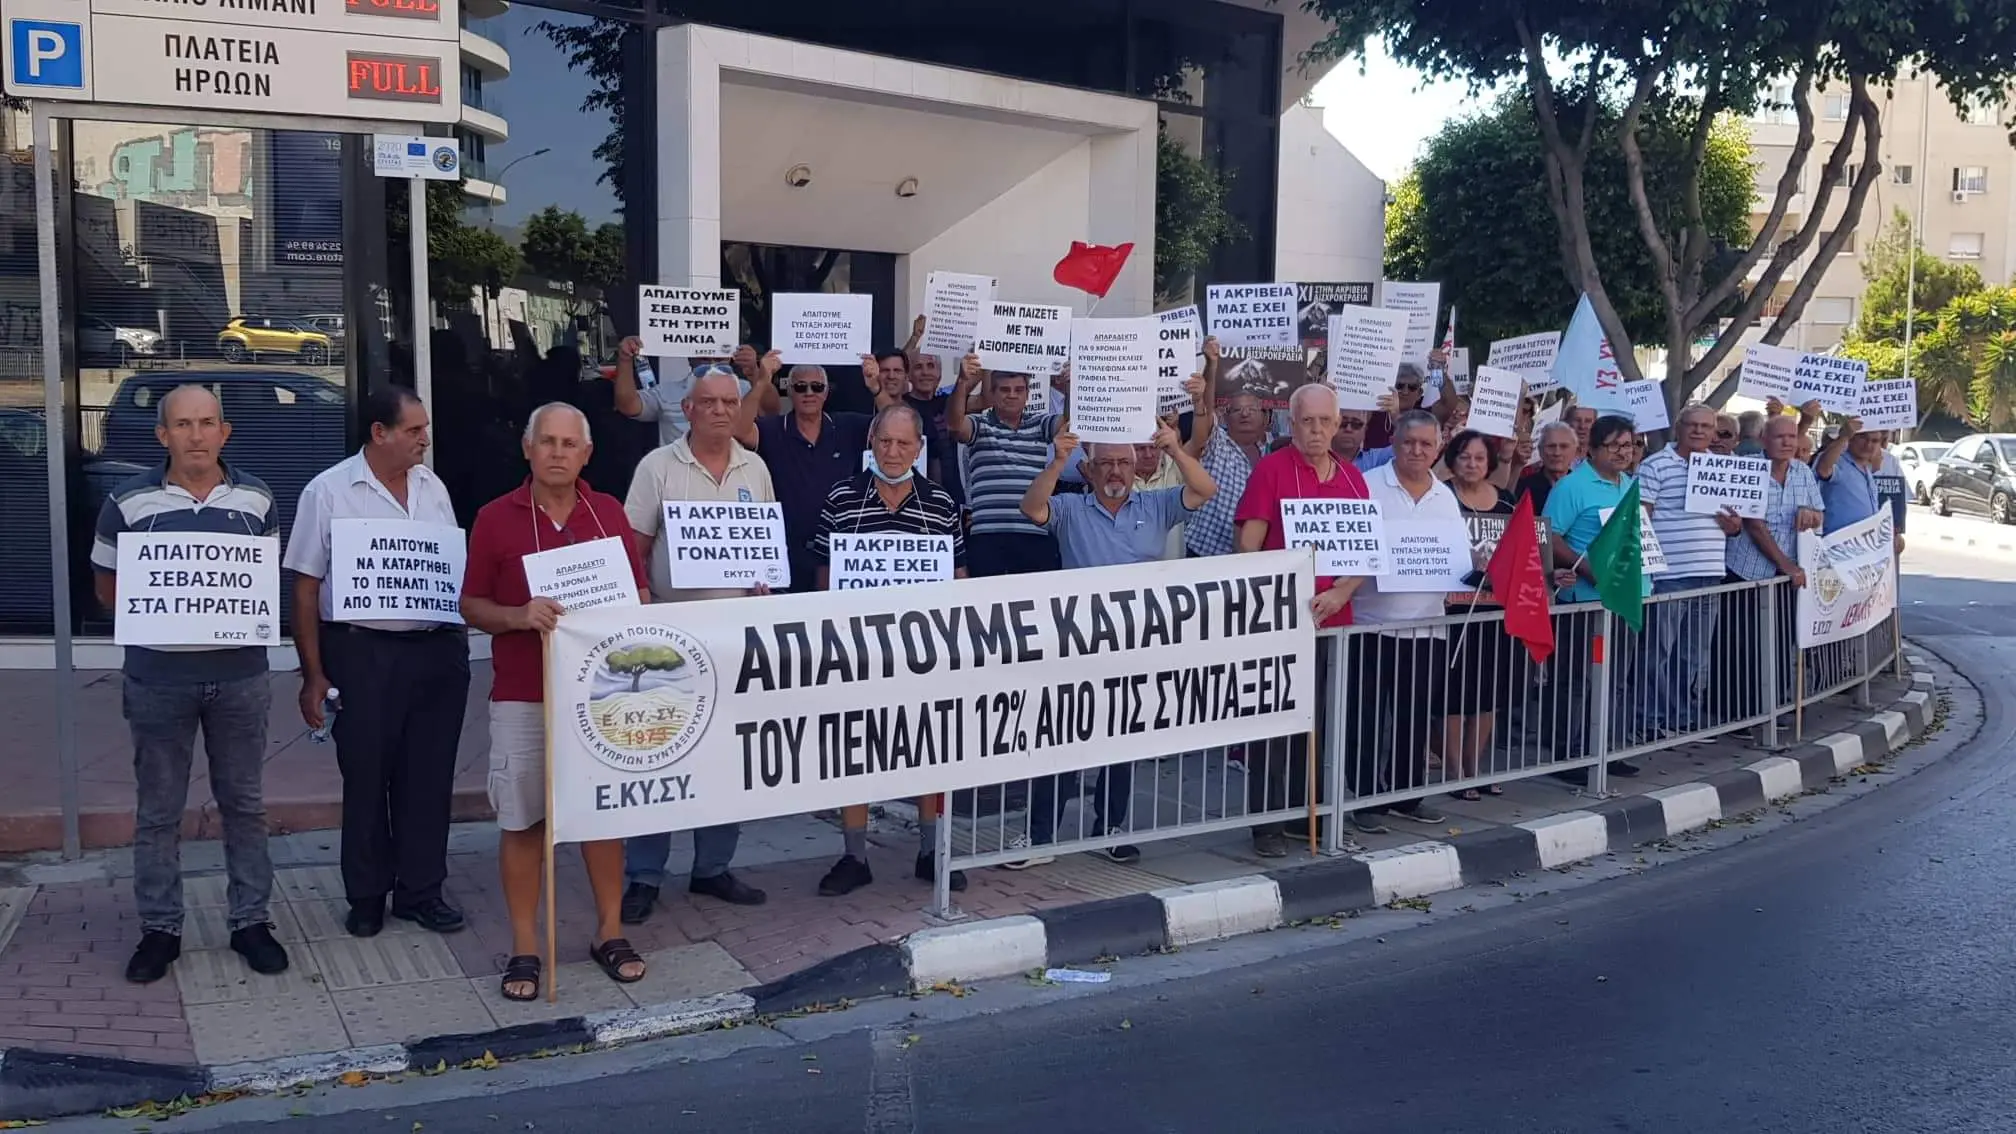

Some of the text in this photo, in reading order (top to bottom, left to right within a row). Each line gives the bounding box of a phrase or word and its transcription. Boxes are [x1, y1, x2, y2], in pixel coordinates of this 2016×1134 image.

[28, 30, 65, 77] P
[165, 34, 280, 65] ΠΛΑΤΕΙΑ
[175, 68, 271, 97] ΗΡΩΩΝ
[349, 60, 440, 96] FULL
[643, 288, 736, 301] ΑΠΑΙΤΟΥΜΕ
[1209, 286, 1293, 299] Η ΑΚΡΙΒΕΙΑ
[1298, 285, 1313, 302] ΧΙ
[650, 303, 728, 316] ΣΕΒΑΣΜΟ
[802, 310, 842, 319] ΑΠΑΙΤΟΥΜΕ
[993, 304, 1058, 320] ΜΗΝ ΠΑΙΖΕΤΕ
[1159, 308, 1196, 323] ΡΙΒΕΙΑ
[1217, 302, 1285, 314] ΜΑΣ ΕΧΕΙ
[648, 318, 730, 330] ΣΤΗ ΤΡΙΤΗ
[1006, 323, 1044, 337] ΜΕ ΤΗΝ
[1213, 316, 1290, 329] ΓΟΝΑΤΙΣΕΙ
[663, 333, 716, 345] ΗΛΙΚΙΑ
[978, 339, 1067, 357] ΑΞΙΟΠΡΕΠΕΙΑ ΜΑΣ
[1800, 355, 1865, 373] ΑΚΡΙΒΕΙΑ
[1824, 370, 1856, 385] ΕΧΕΙ
[1793, 379, 1857, 398] ΟΝΑΤΙΣΕΙ
[1883, 392, 1908, 403] ΕΧΕΙ
[1857, 404, 1912, 417] ΟΝΑΤΙΣΕΙ
[1692, 456, 1769, 472] Η ΑΚΡΙΒΕΙΑ
[1697, 471, 1760, 486] ΜΑΣ ΕΧΕΙ
[1692, 485, 1763, 500] ΓΟΝΑΤΙΣΕΙ
[667, 506, 779, 520] Η ΑΚΡΙΒΕΙΑ
[1284, 503, 1378, 516] Η ΑΚΡΙΒΕΙΑ
[681, 526, 771, 540] ΜΑΣ ΕΧΕΙ
[1294, 521, 1372, 534] ΜΑΣ ΕΧΕΙ
[370, 538, 440, 555] ΑΠΑΙΤΟΥΜΕ
[833, 539, 949, 552] Η ΑΚΡΙΒΕΙΑ
[1291, 539, 1379, 551] ΓΟΝΑΤΙΣΕΙ
[138, 544, 263, 563] ΑΠΑΙΤΟΥΜΕ
[677, 546, 780, 560] ΓΟΝΑΤΙΣΕΙ
[356, 557, 451, 575] ΝΑ ΚΑΤΑΡΓΗΘΕΙ
[556, 558, 606, 575] ΑΠΑΡΑΔΕΚΤΟ
[844, 558, 938, 572] ΜΑΣ ΕΧΕΙ
[1331, 559, 1360, 567] ΕΚΥΣΥ
[148, 571, 253, 588] ΣΕΒΑΣΜΟ
[723, 570, 756, 578] ΕΚΥΣΥ
[352, 576, 457, 594] ΤΟ ΠΕΝΑΛΤΙ 12%
[540, 583, 553, 592] ΓΙΑ
[561, 576, 590, 589] ΧΡΟΝΙΑ
[553, 588, 590, 601] ΒΕΡΝΗΣΗ
[127, 598, 270, 616] ΣΤΑ ΓΗΡΑΤΕΙΑ
[343, 596, 458, 613] ΑΠΟ ΤΙΣ ΣΥΝΤΑΞΕΙ
[734, 572, 1298, 694] ΑΠΑΙΤΟΥΜΕ ΚΑΤΑΡΓΗΣΗ
[577, 626, 709, 683] ΚΑΛΥΤΕΡΗ ΠΟΙΟΤΗΤΑ ΖΩΗΣ
[735, 716, 808, 791] ΤΟΥ
[818, 697, 964, 782] ΠΕΝΑΛΤΙ
[1034, 680, 1096, 749] ΑΠΟ
[1103, 673, 1149, 738] ΤΙΣ
[1152, 653, 1298, 730] ΣΥΝΤΑΞΕΙΣ
[577, 695, 707, 766] ΕΝΩΣΗ ΚΥΠΡΙΩΝ ΣΥΝΤΑΞΙΟΥΧΩΝ
[595, 774, 695, 811] Ε.ΚΥ.ΣΥ.
